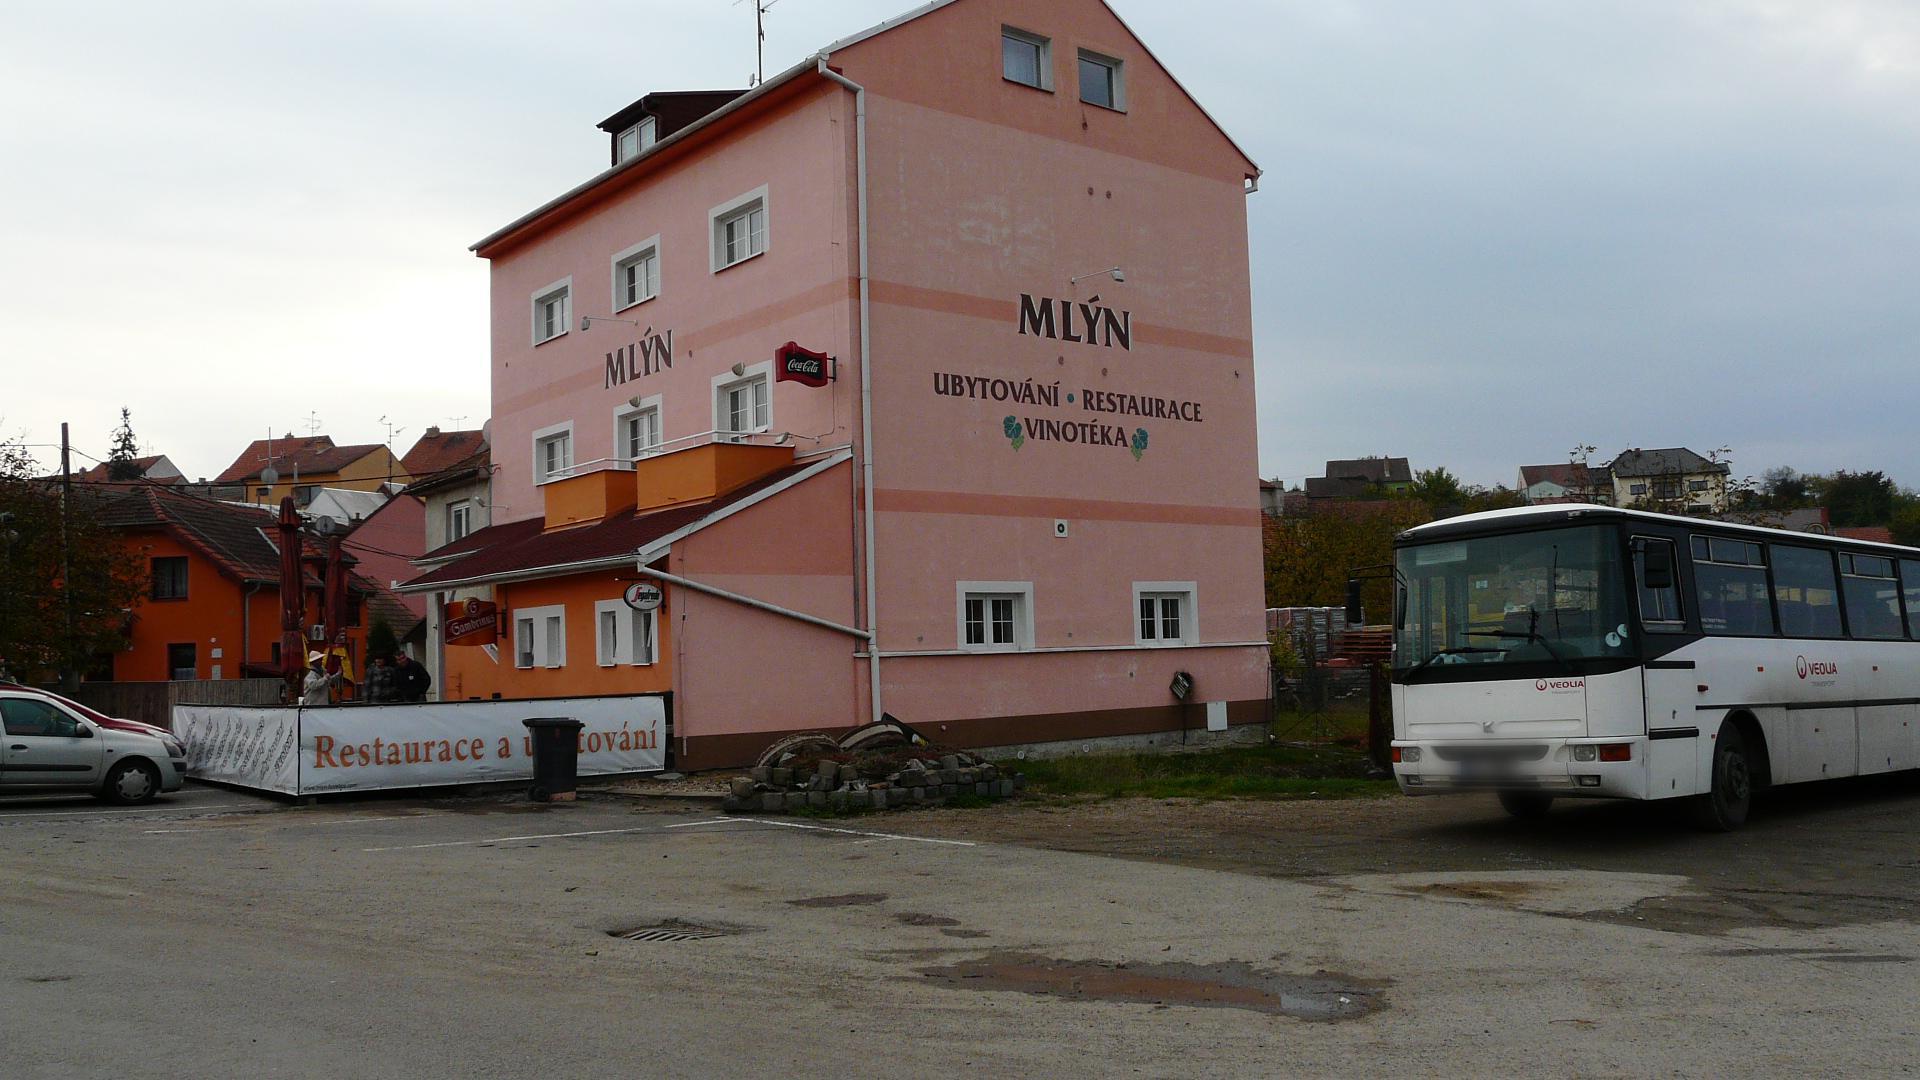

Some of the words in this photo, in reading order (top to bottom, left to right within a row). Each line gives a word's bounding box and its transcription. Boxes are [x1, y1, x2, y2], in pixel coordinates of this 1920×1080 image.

[1018, 293, 1132, 351] MLÝN
[605, 325, 673, 390] MLÝN
[933, 372, 1060, 407] UBYTOVÁNÍ
[1082, 389, 1203, 423] RESTAURACE
[1024, 418, 1129, 448] VINOTÉKA
[1549, 680, 1585, 689] VEOLIA
[1808, 662, 1838, 675] VEOLIA
[313, 735, 485, 769] Restaurace
[497, 735, 512, 759] a
[523, 720, 658, 757] utování
